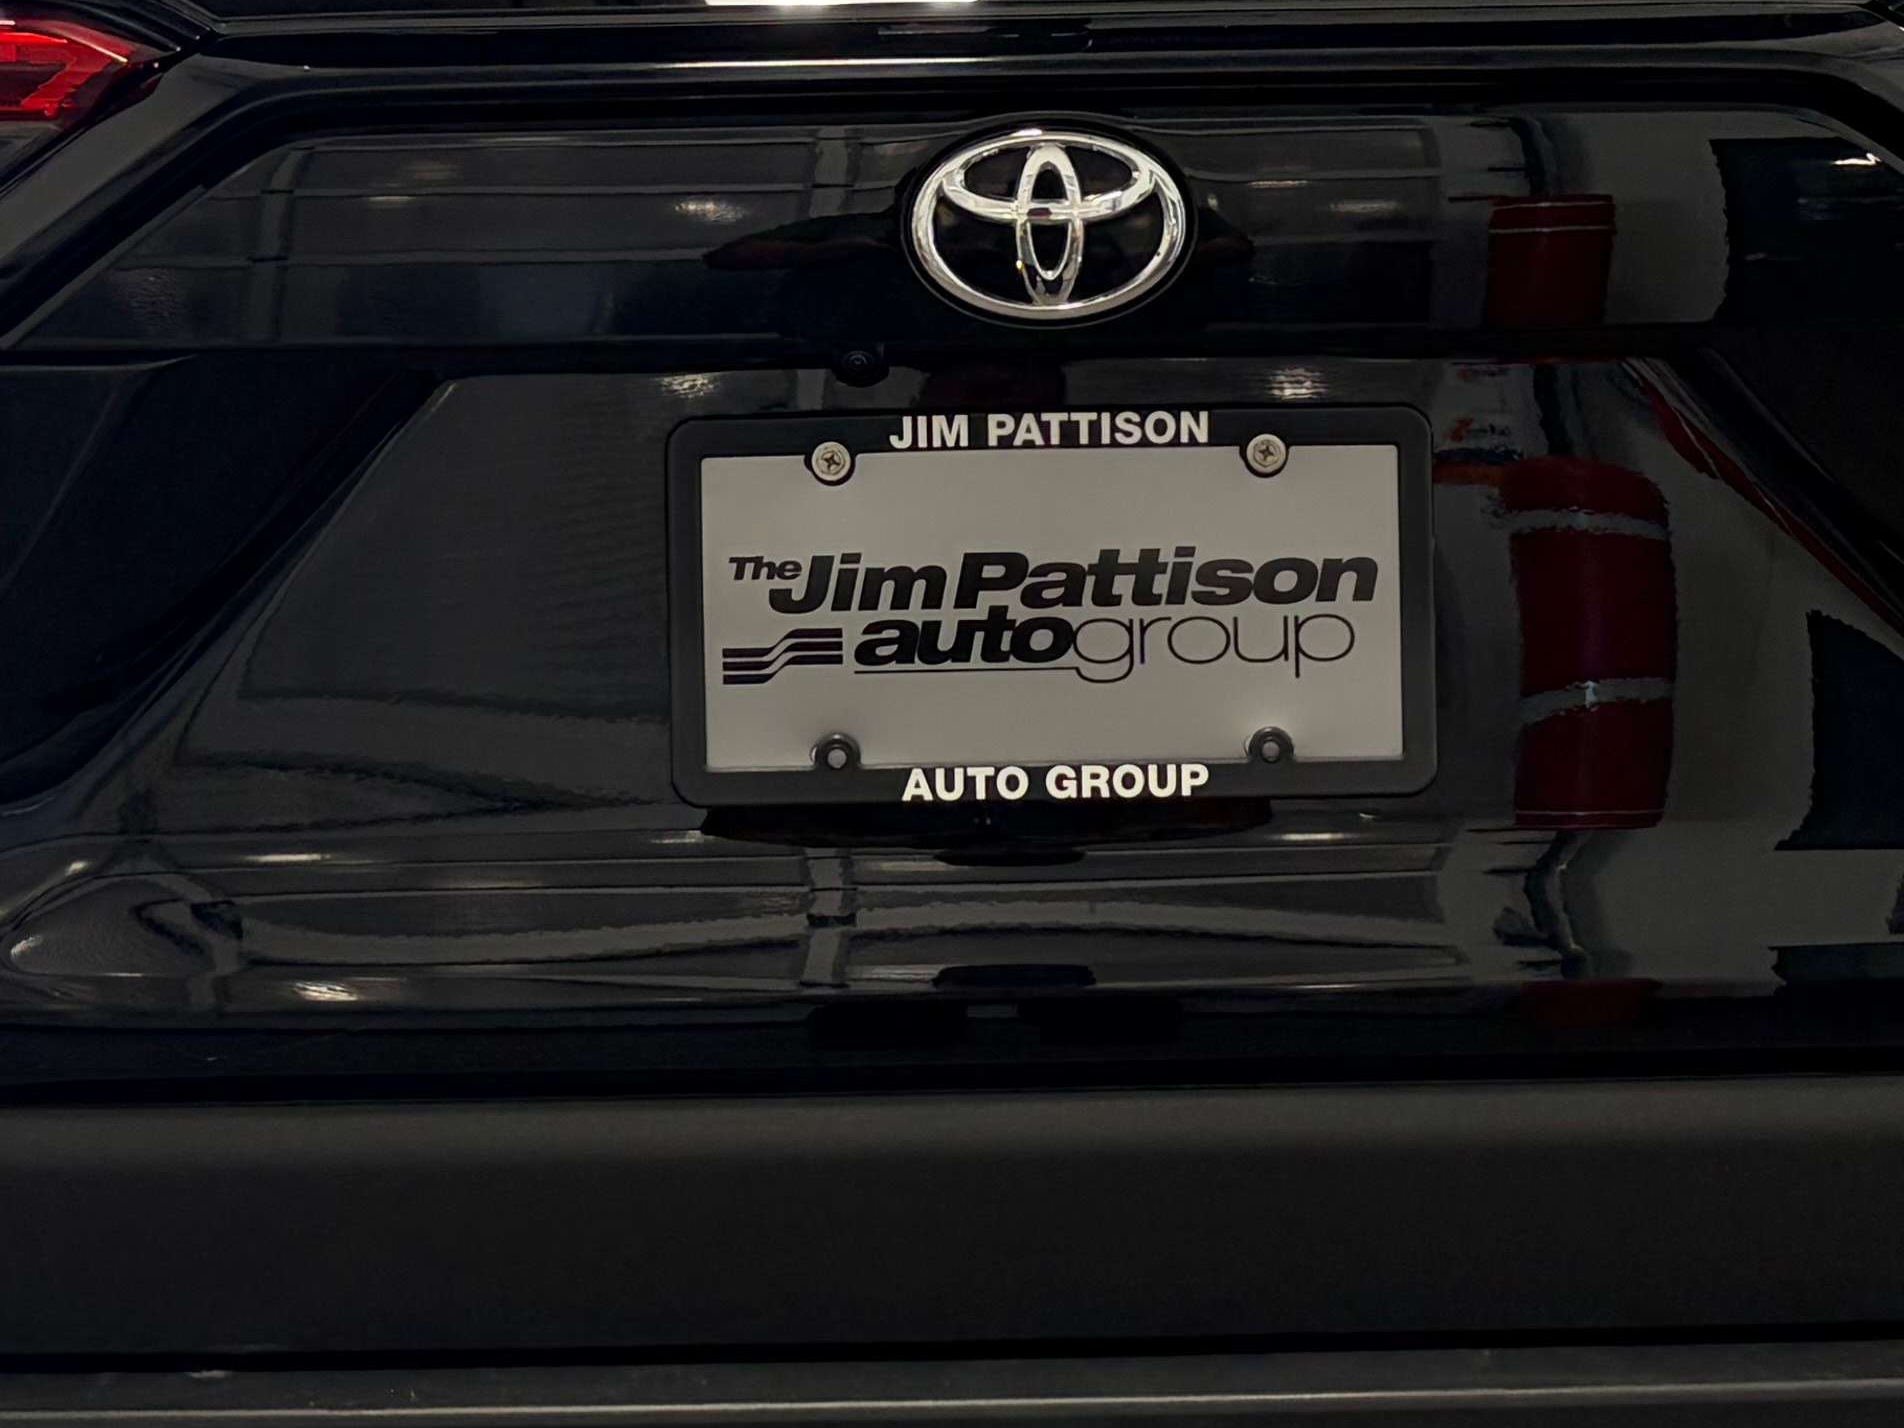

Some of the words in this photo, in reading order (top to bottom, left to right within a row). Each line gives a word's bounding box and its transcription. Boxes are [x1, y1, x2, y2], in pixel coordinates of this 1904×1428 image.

[889, 413, 970, 450] JIM
[986, 410, 1211, 448] PATTISON
[728, 555, 802, 583] The
[901, 766, 1030, 803] AUTO
[1045, 763, 1211, 800] GROUP
